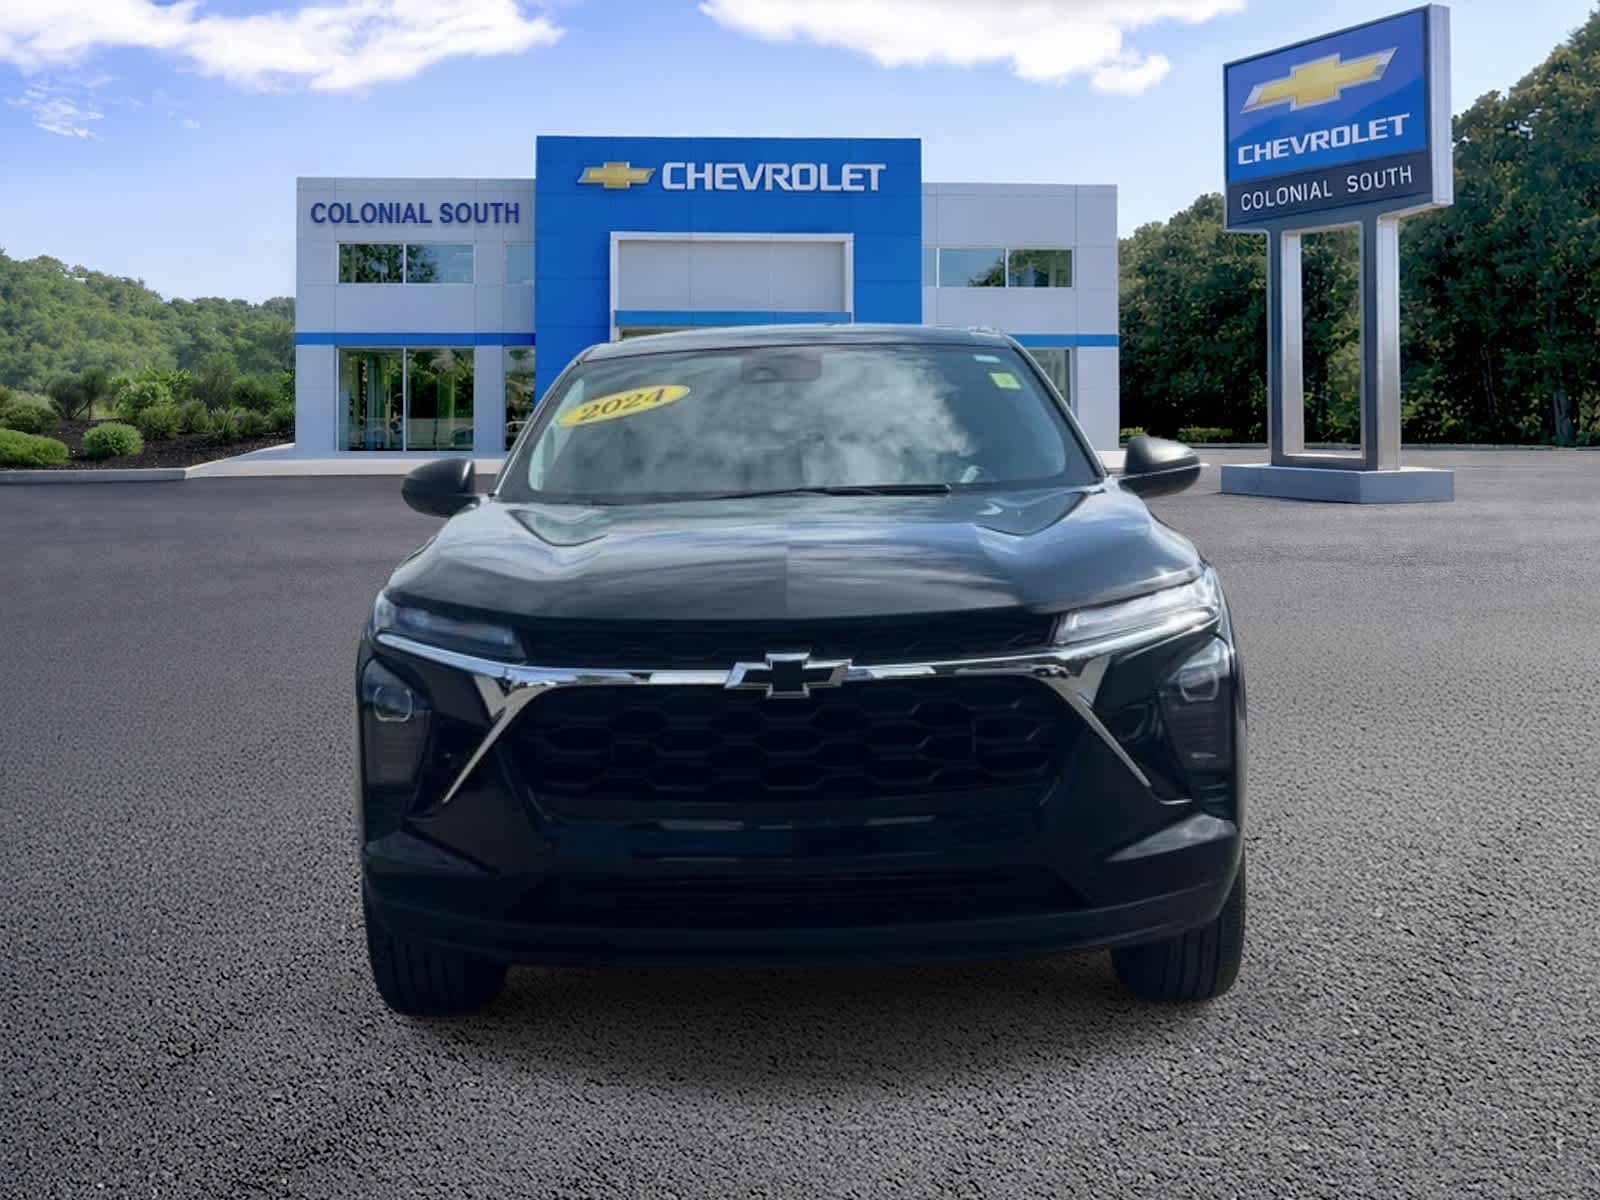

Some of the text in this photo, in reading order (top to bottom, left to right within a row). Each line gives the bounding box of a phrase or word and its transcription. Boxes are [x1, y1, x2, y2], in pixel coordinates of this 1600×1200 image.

[1238, 113, 1410, 165] CHEVROLET
[662, 162, 887, 192] CHEVROLET
[1241, 165, 1412, 211] COLONIAL SOUTH
[310, 202, 520, 225] COLONIAL SOUTH
[578, 388, 665, 421] 2024
